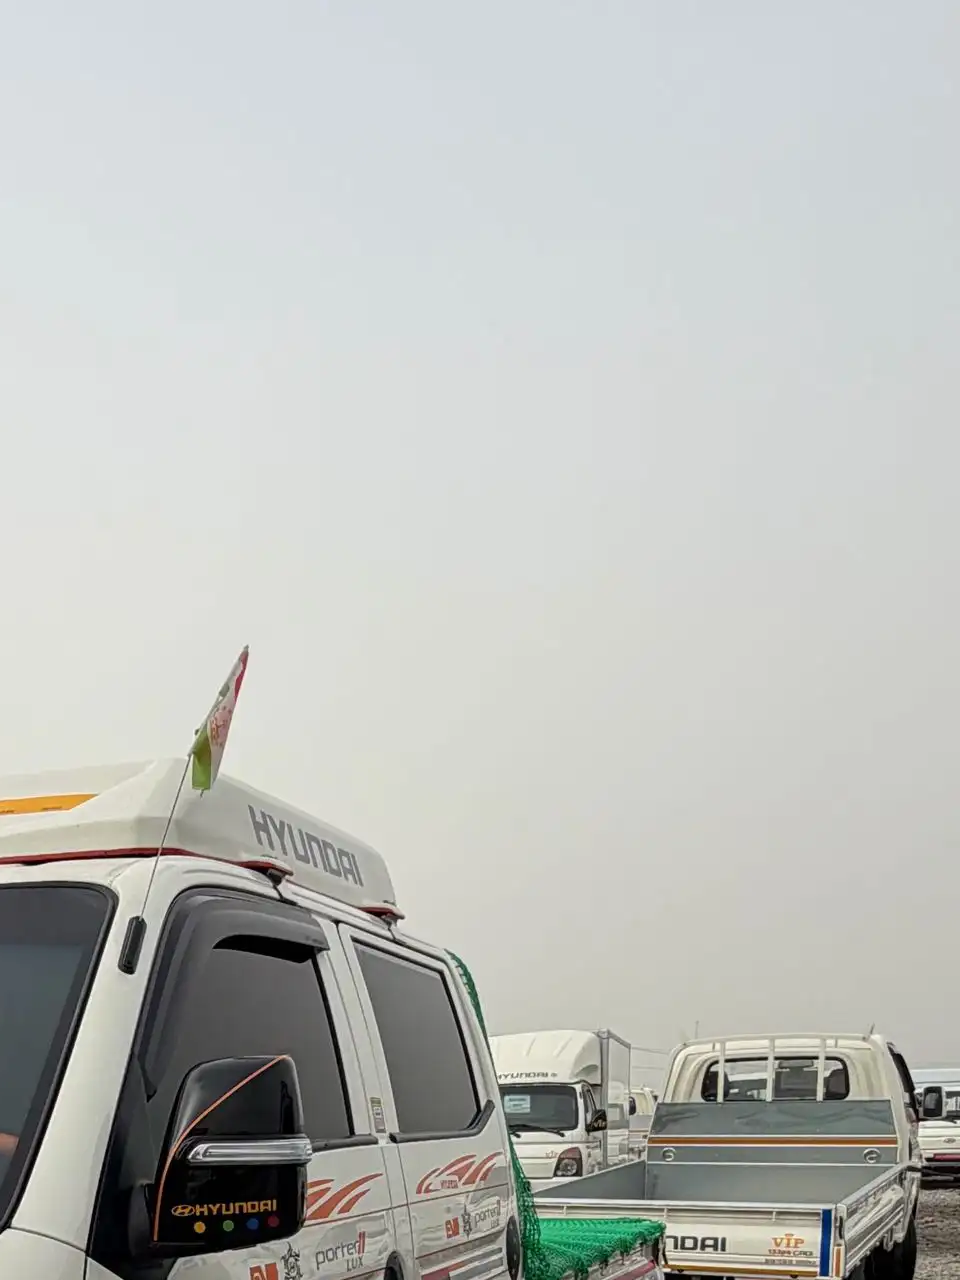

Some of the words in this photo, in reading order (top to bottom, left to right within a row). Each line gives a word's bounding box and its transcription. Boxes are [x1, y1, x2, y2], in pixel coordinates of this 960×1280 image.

[247, 804, 365, 887] HYUNDAI
[195, 1199, 277, 1216] HYUNDAI
[665, 1235, 727, 1252] NDAI
[772, 1236, 805, 1249] VIP
[346, 1254, 364, 1272] LUX
